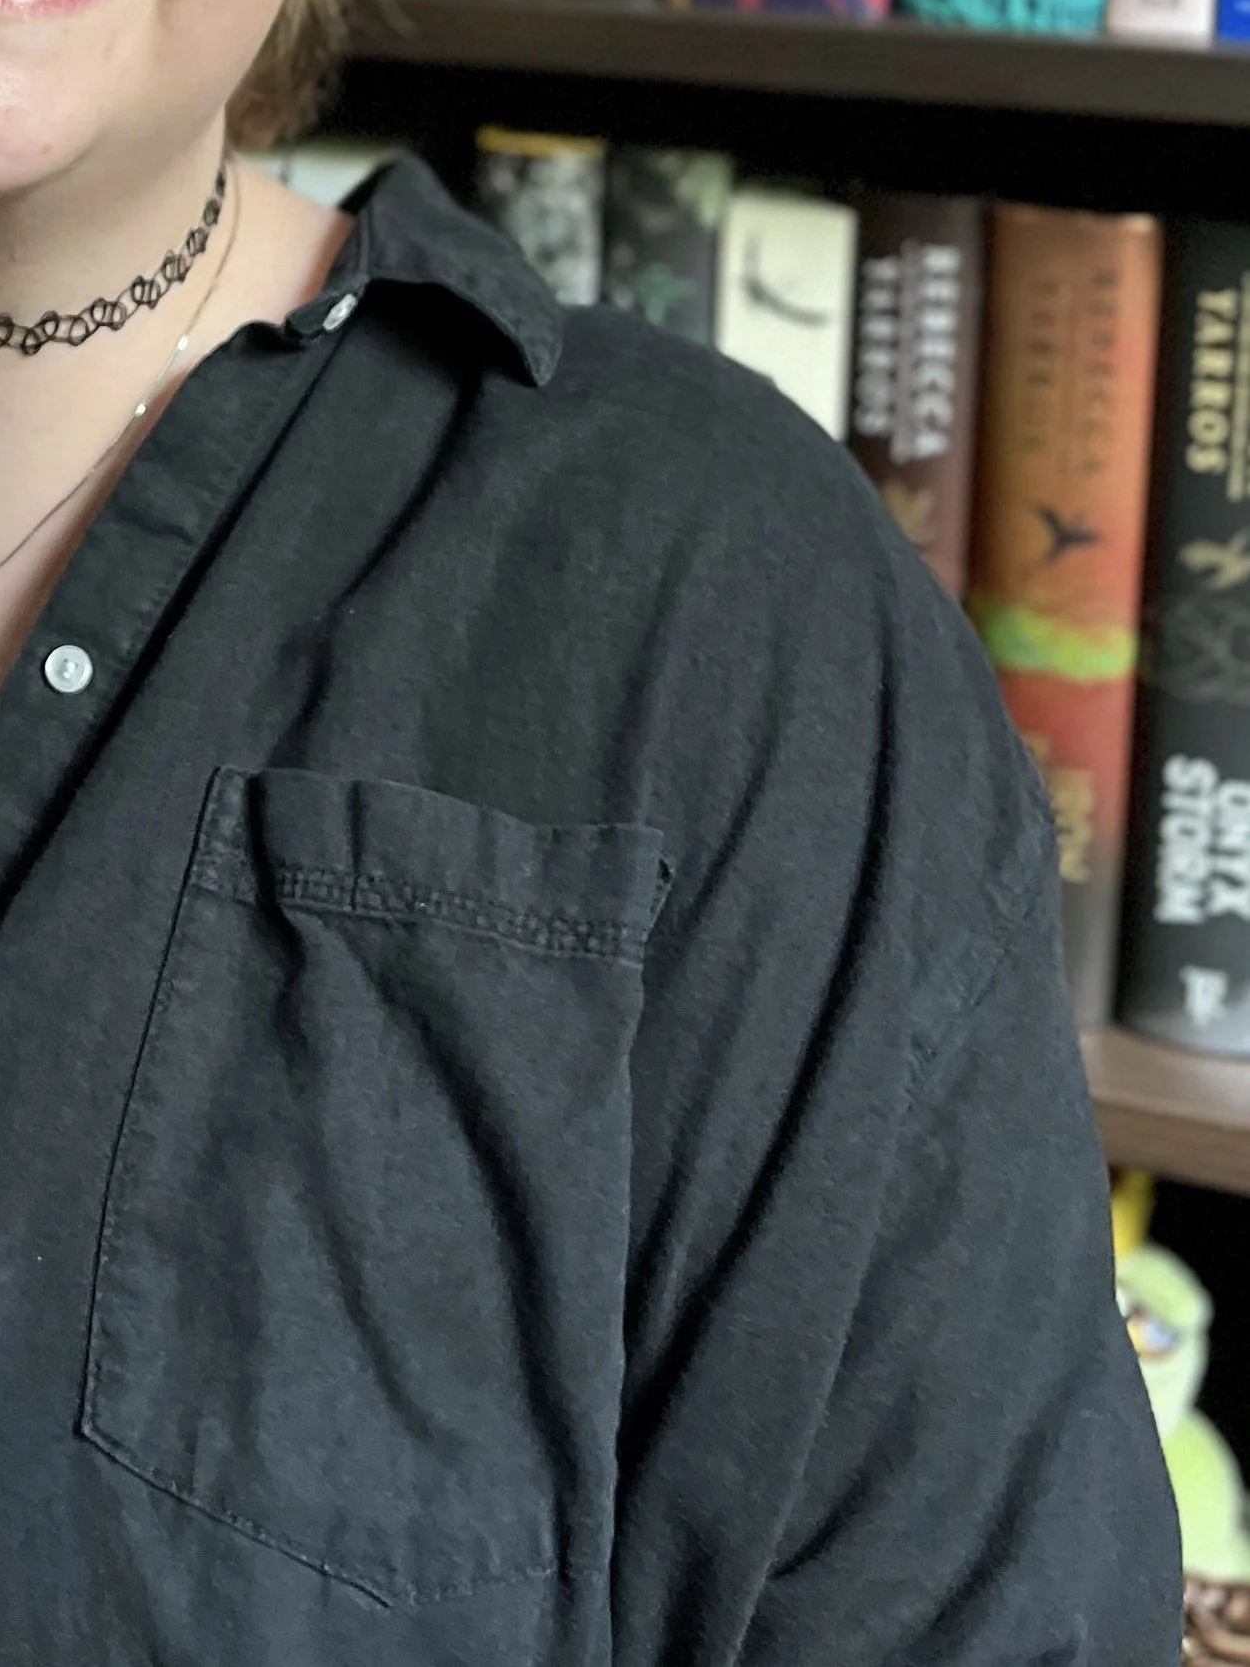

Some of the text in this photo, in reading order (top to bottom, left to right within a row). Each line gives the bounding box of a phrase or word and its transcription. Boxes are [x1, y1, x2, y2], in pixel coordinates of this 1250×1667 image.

[913, 244, 962, 459] REBECCA
[1184, 288, 1237, 476] YARROS
[1154, 752, 1218, 925] STORM
[1207, 778, 1250, 921] ONYX
